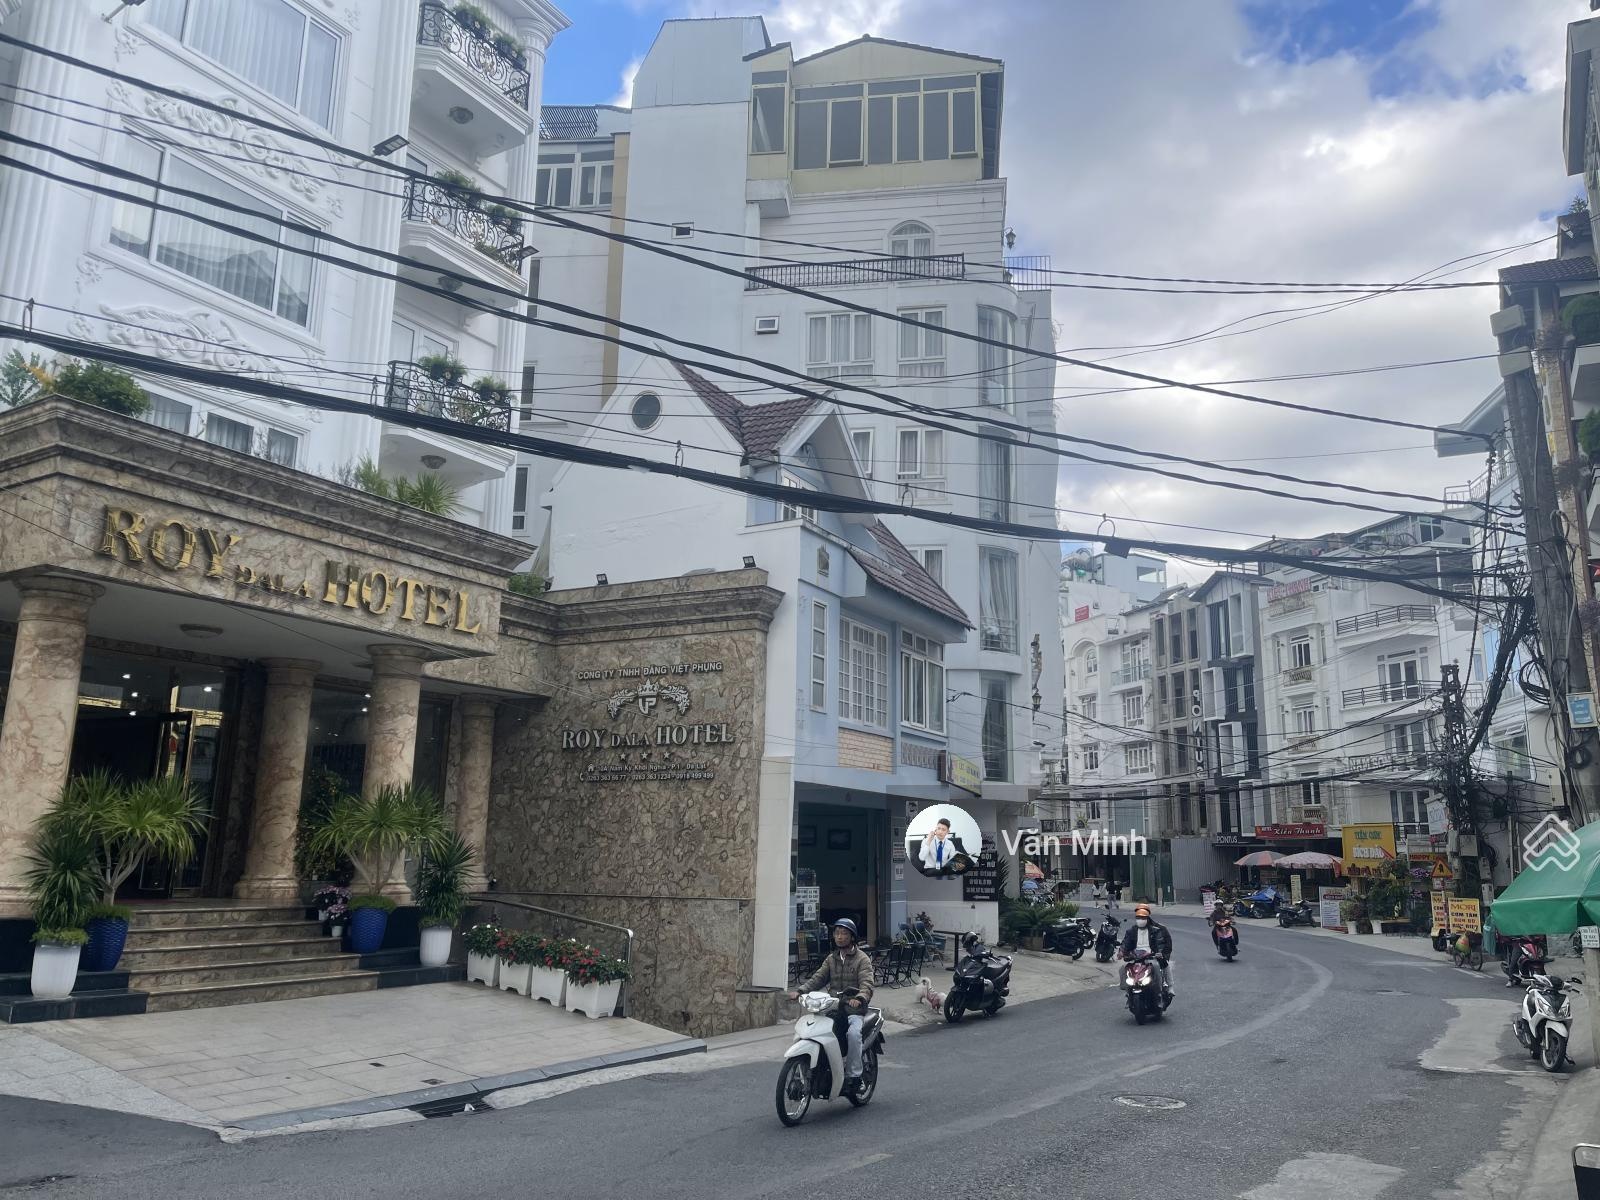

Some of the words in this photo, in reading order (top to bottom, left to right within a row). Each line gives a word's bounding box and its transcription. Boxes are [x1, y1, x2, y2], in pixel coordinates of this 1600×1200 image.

[100, 506, 243, 578] ROY
[236, 565, 312, 599] DALA
[322, 559, 482, 635] HOTEL
[604, 669, 614, 678] TY
[618, 667, 640, 677] TNHH
[562, 728, 606, 749] ROY
[611, 732, 650, 747] DALA
[656, 722, 734, 745] HOTEL
[1216, 835, 1238, 844] PONTUS
